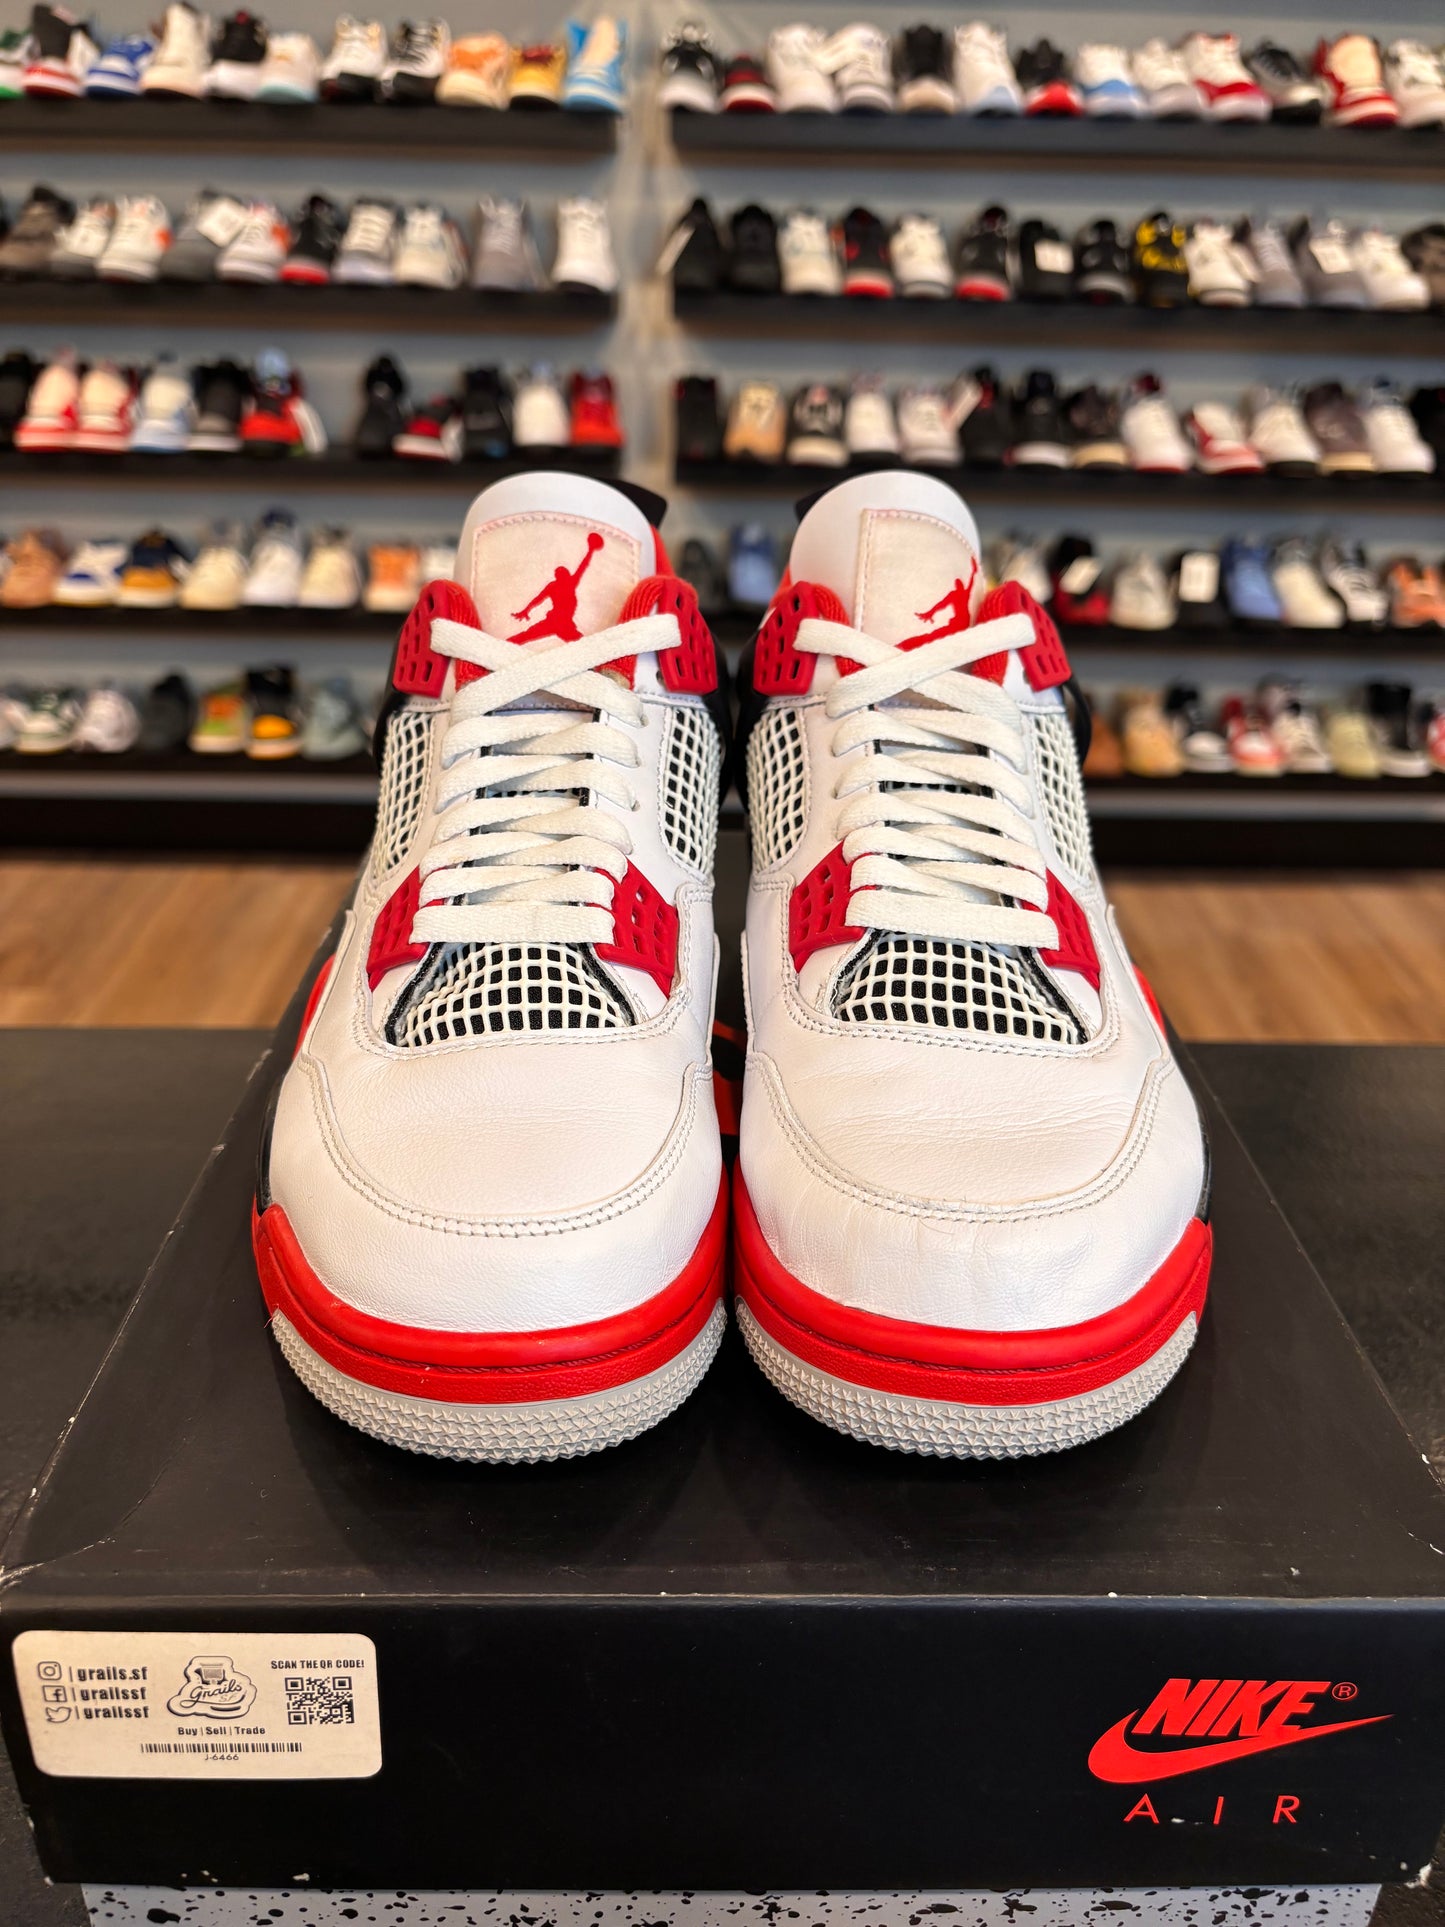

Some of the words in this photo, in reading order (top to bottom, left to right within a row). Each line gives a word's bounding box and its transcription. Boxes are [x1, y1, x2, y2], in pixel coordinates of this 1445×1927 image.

[270, 1659, 297, 1669] SCAN
[300, 1659, 318, 1669] THE
[320, 1659, 333, 1669] QR
[335, 1659, 365, 1668] CODE!
[77, 1666, 148, 1681] grails.sf
[80, 1686, 147, 1701] grailssf
[83, 1706, 149, 1720] grailssf
[1131, 1678, 1331, 1736] NIKE
[177, 1726, 198, 1736] Buy
[205, 1726, 227, 1735] Sell
[234, 1726, 266, 1735] Trade
[1123, 1793, 1300, 1824] AIR
